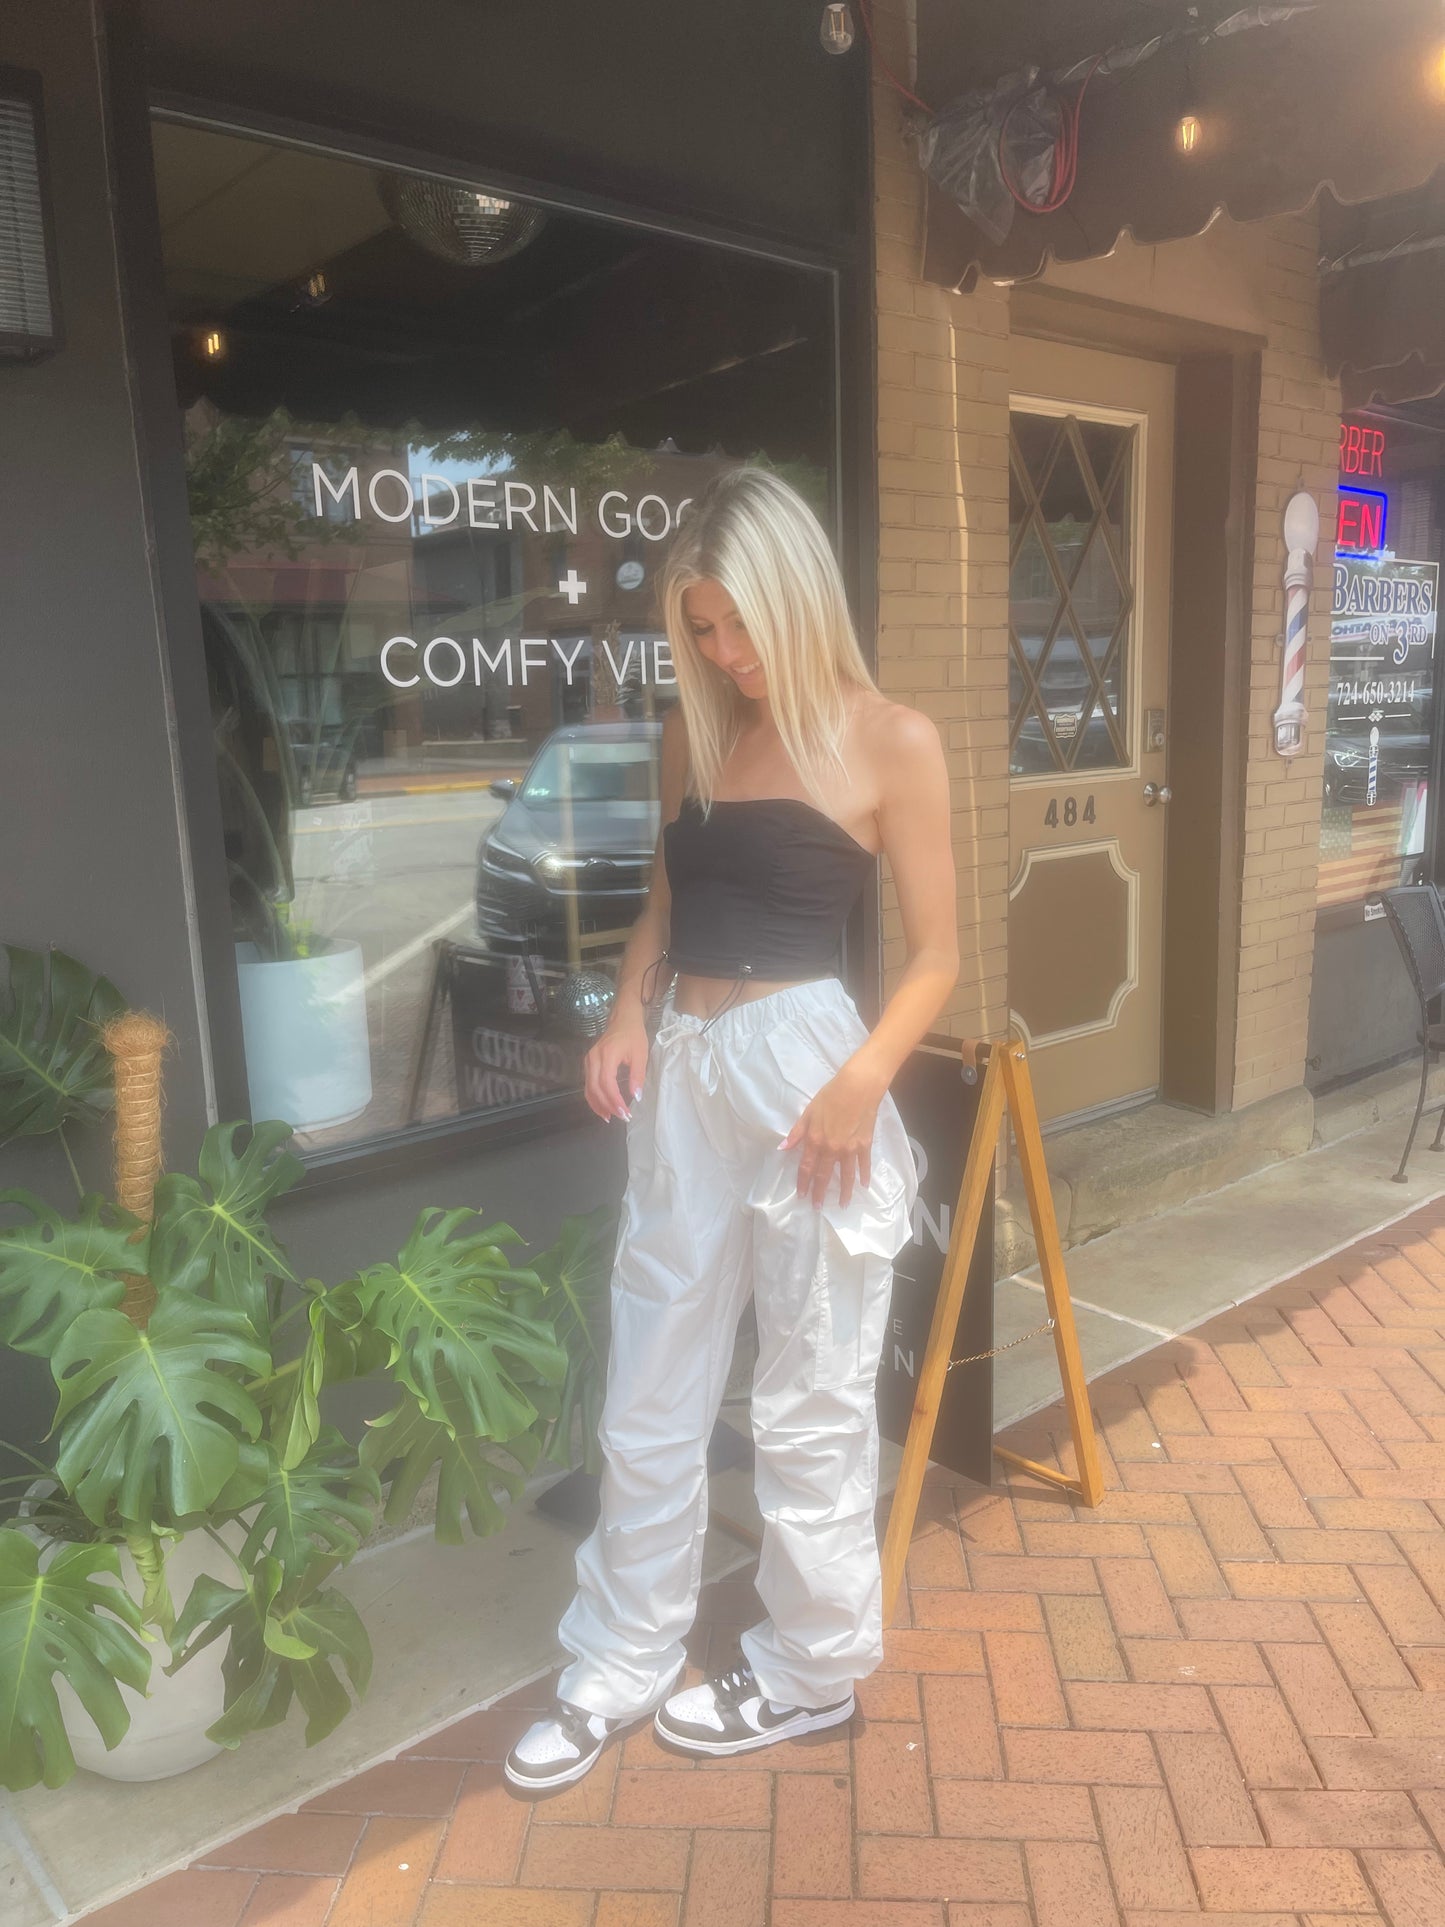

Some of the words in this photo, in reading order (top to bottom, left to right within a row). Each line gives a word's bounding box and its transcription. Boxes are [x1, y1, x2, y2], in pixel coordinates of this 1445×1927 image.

[312, 462, 577, 535] MODERN
[1331, 562, 1433, 616] BARBERS
[1370, 623, 1389, 645] ON
[380, 636, 584, 688] COMFY
[1337, 680, 1415, 706] 724-650-3214
[1044, 795, 1096, 828] 484
